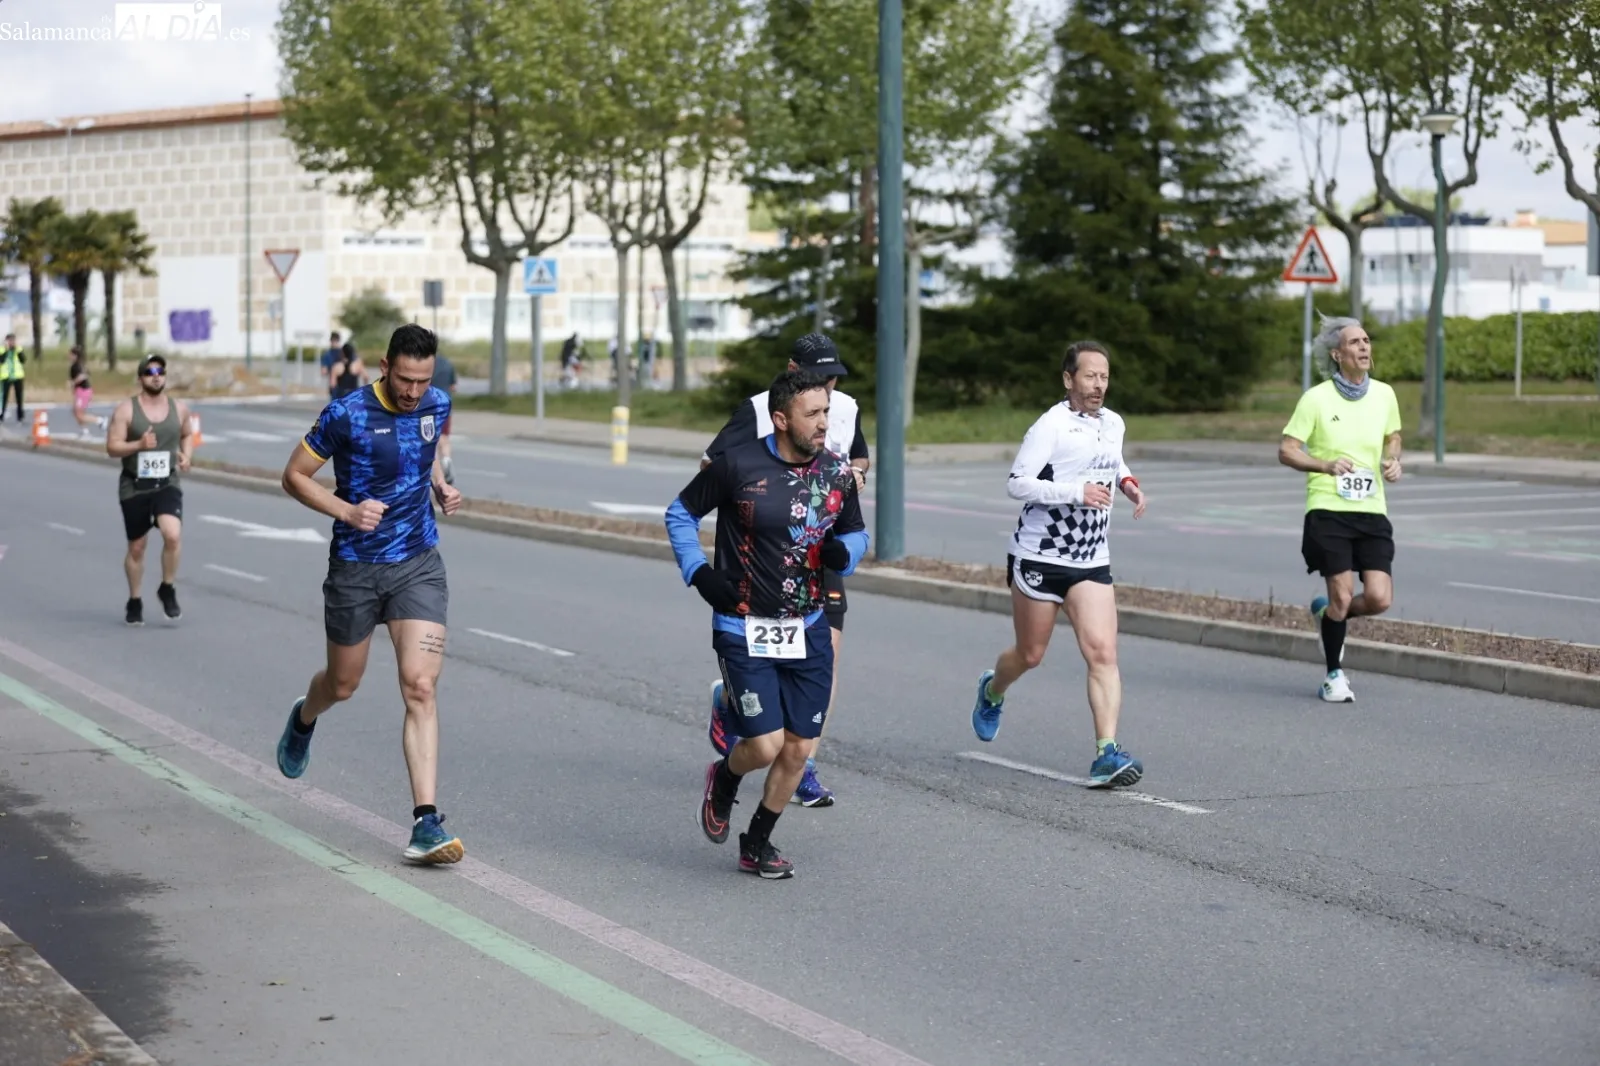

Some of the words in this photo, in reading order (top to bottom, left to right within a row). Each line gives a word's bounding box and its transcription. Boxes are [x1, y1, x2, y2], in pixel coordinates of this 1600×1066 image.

[143, 458, 166, 469] 365
[1342, 477, 1373, 494] 387
[753, 625, 799, 645] 237
